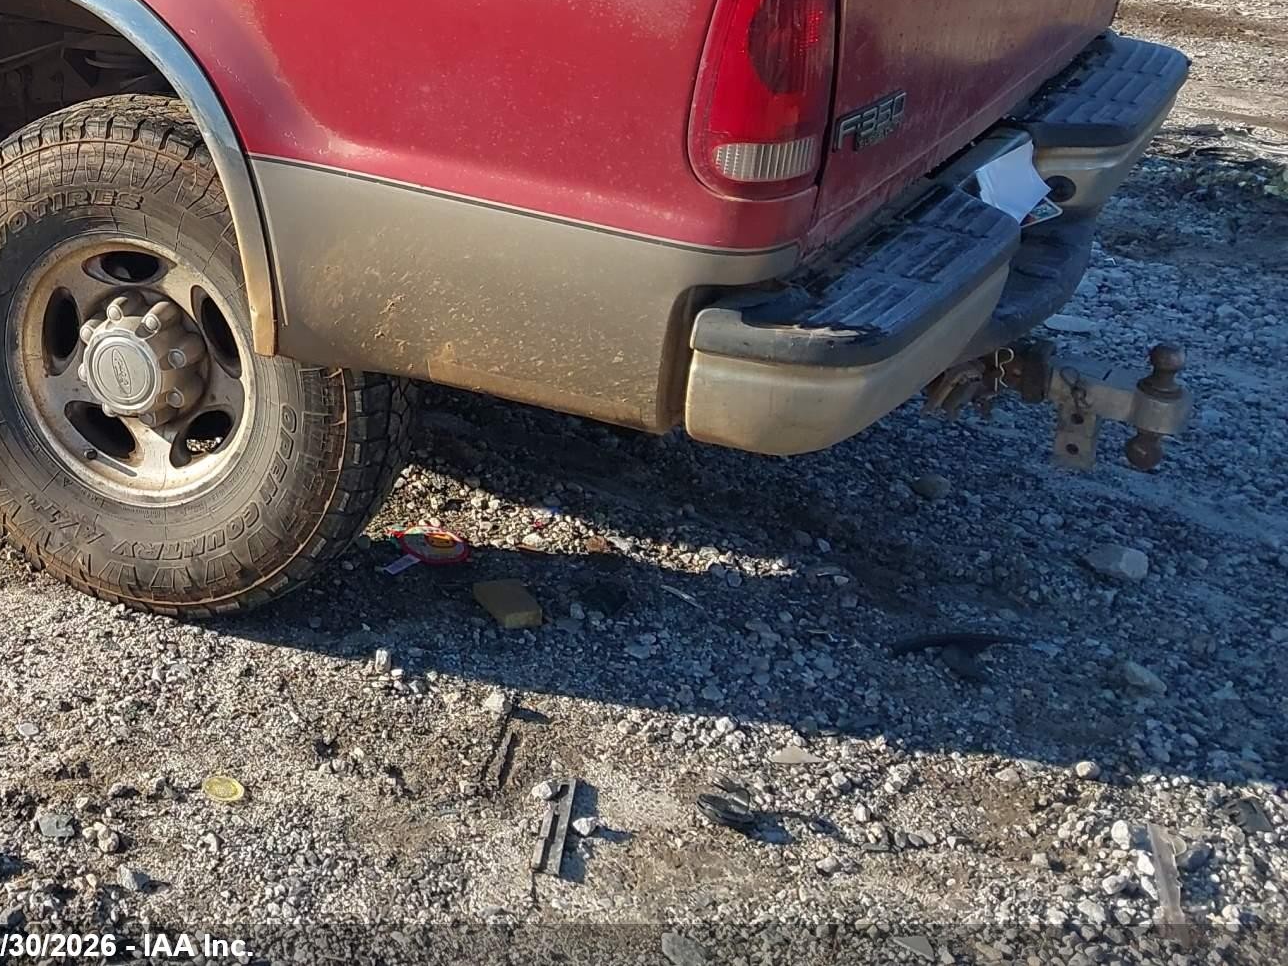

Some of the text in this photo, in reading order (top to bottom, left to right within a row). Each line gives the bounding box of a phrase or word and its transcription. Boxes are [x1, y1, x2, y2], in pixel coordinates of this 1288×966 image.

[31, 188, 145, 222] TIRES
[259, 402, 297, 506] OPEN
[112, 501, 261, 561] COUNTRY
